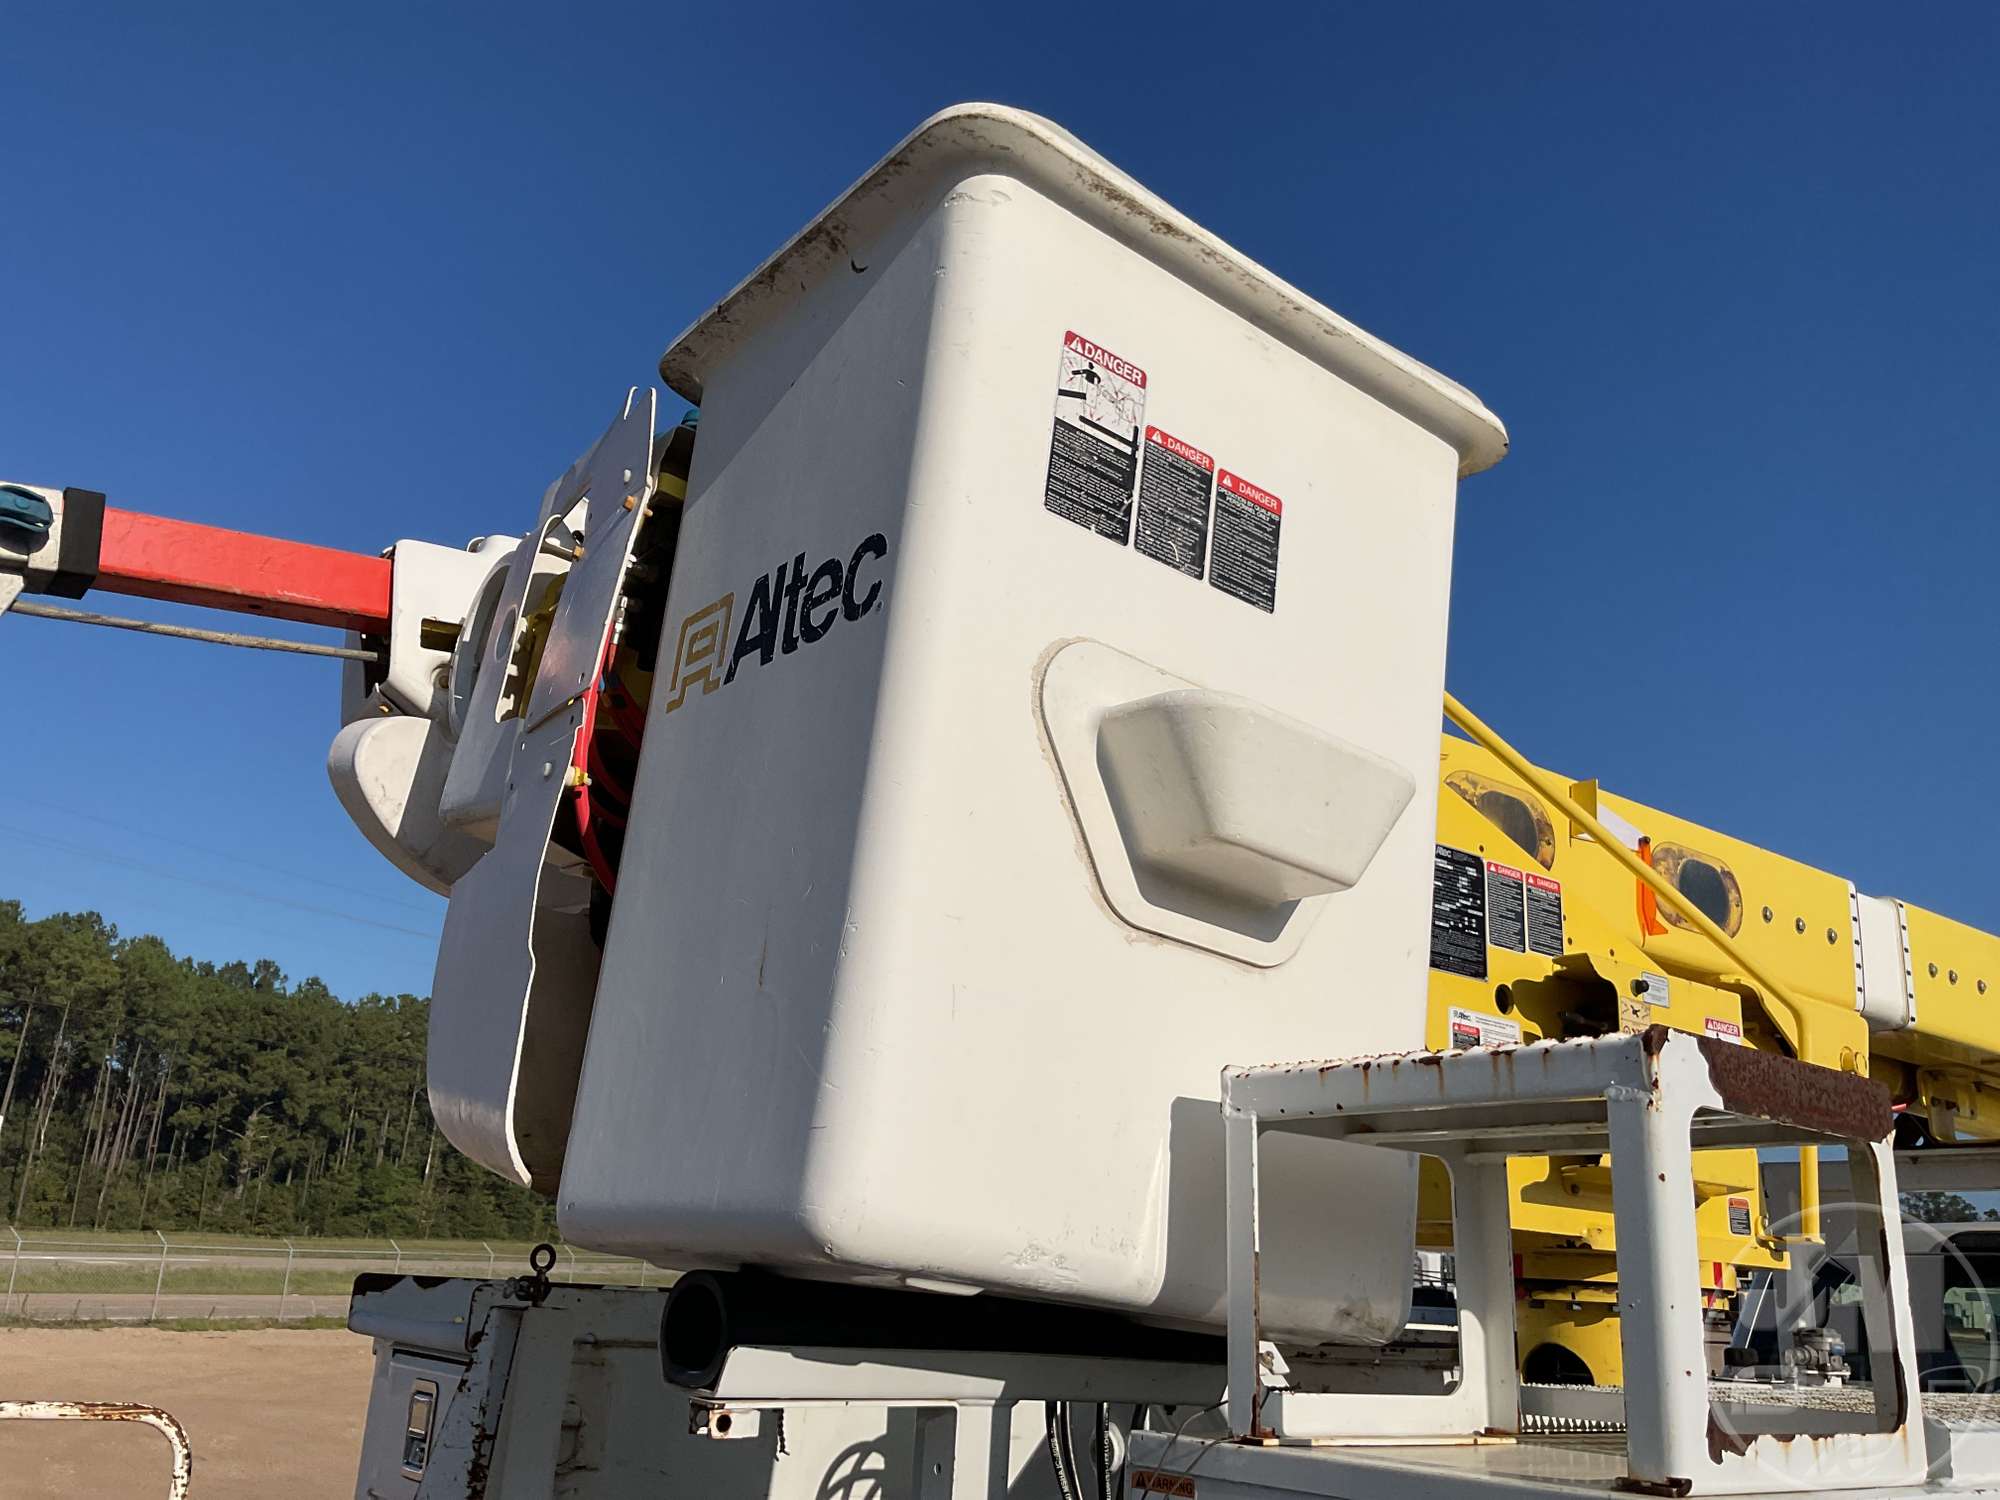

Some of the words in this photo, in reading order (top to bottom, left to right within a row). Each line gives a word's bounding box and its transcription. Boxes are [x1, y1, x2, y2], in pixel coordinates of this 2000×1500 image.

[1085, 342, 1142, 385] DANGER
[1168, 438, 1209, 468] DANGER
[1239, 482, 1277, 510] DANGER
[723, 532, 887, 685] Altec
[1498, 866, 1521, 879] DANGER
[1536, 877, 1558, 889] DANGER
[1713, 1020, 1738, 1033] DANGER
